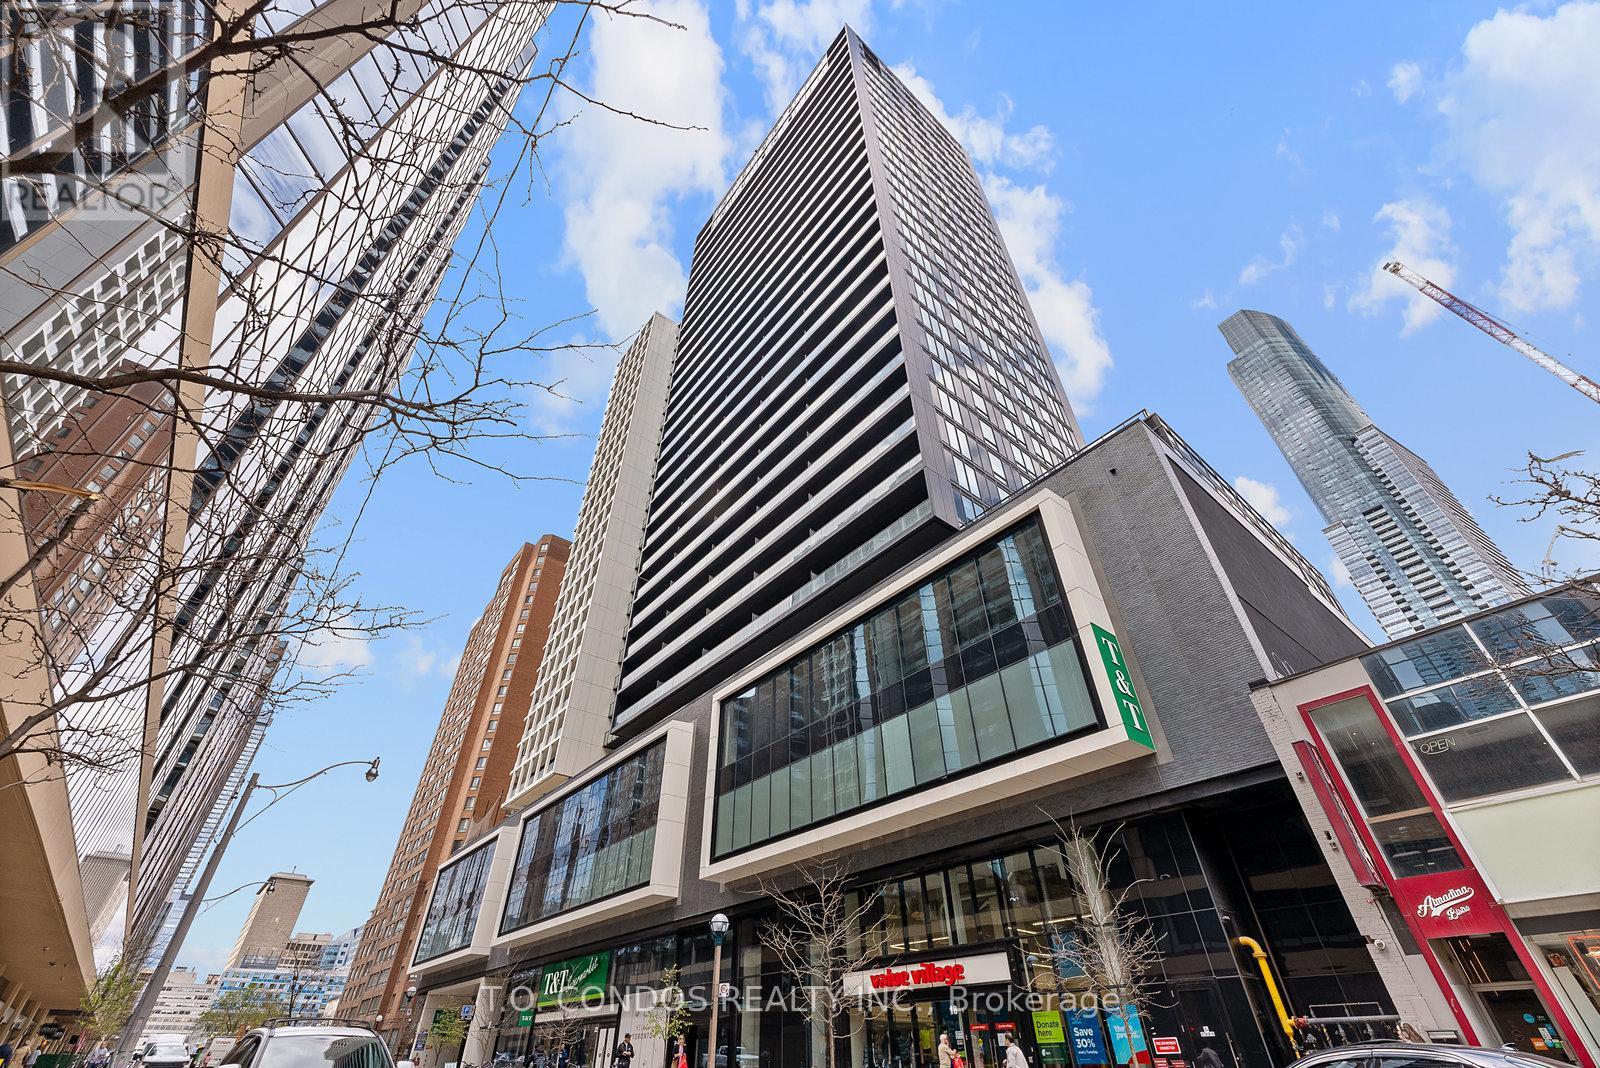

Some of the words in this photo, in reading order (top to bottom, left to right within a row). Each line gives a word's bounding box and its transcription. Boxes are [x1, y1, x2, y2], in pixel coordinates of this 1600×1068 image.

[1101, 636, 1143, 731] T&T
[1420, 736, 1456, 754] OPEN
[1417, 886, 1474, 917] Almadina
[544, 969, 569, 995] T&T
[870, 968, 910, 988] value
[911, 963, 965, 986] village
[1073, 1027, 1093, 1036] Save
[1075, 1038, 1096, 1048] 30%
